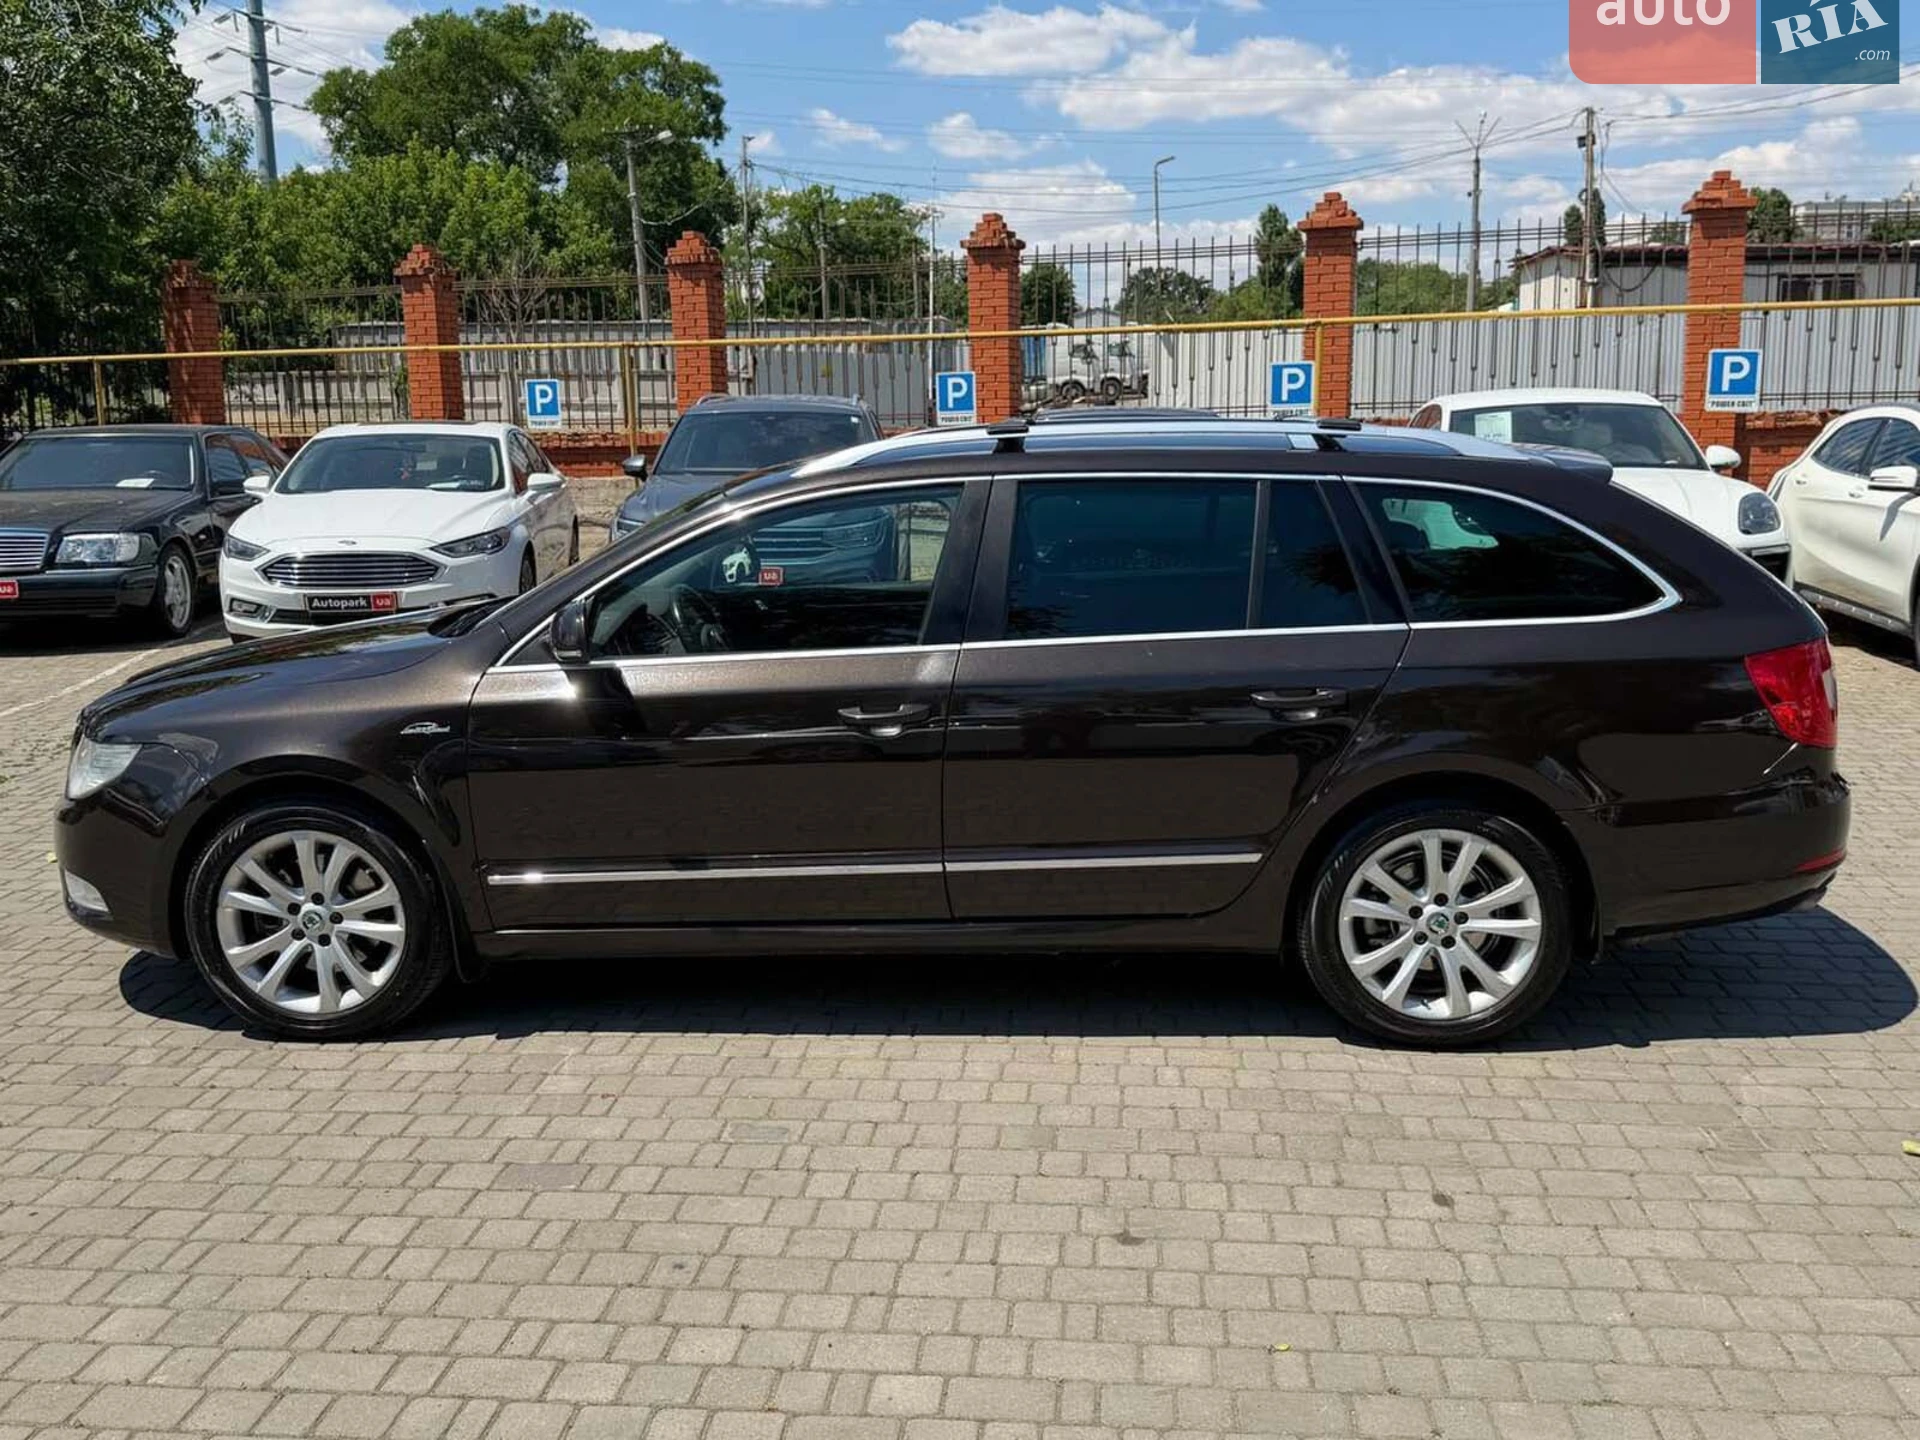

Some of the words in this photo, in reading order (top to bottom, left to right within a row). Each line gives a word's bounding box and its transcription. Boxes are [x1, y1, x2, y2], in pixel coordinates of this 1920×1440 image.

[1281, 367, 1306, 401] P
[1721, 355, 1750, 391] P
[535, 384, 553, 413] P
[947, 377, 968, 409] P
[311, 597, 368, 610] Autopark
[375, 597, 391, 606] ua
